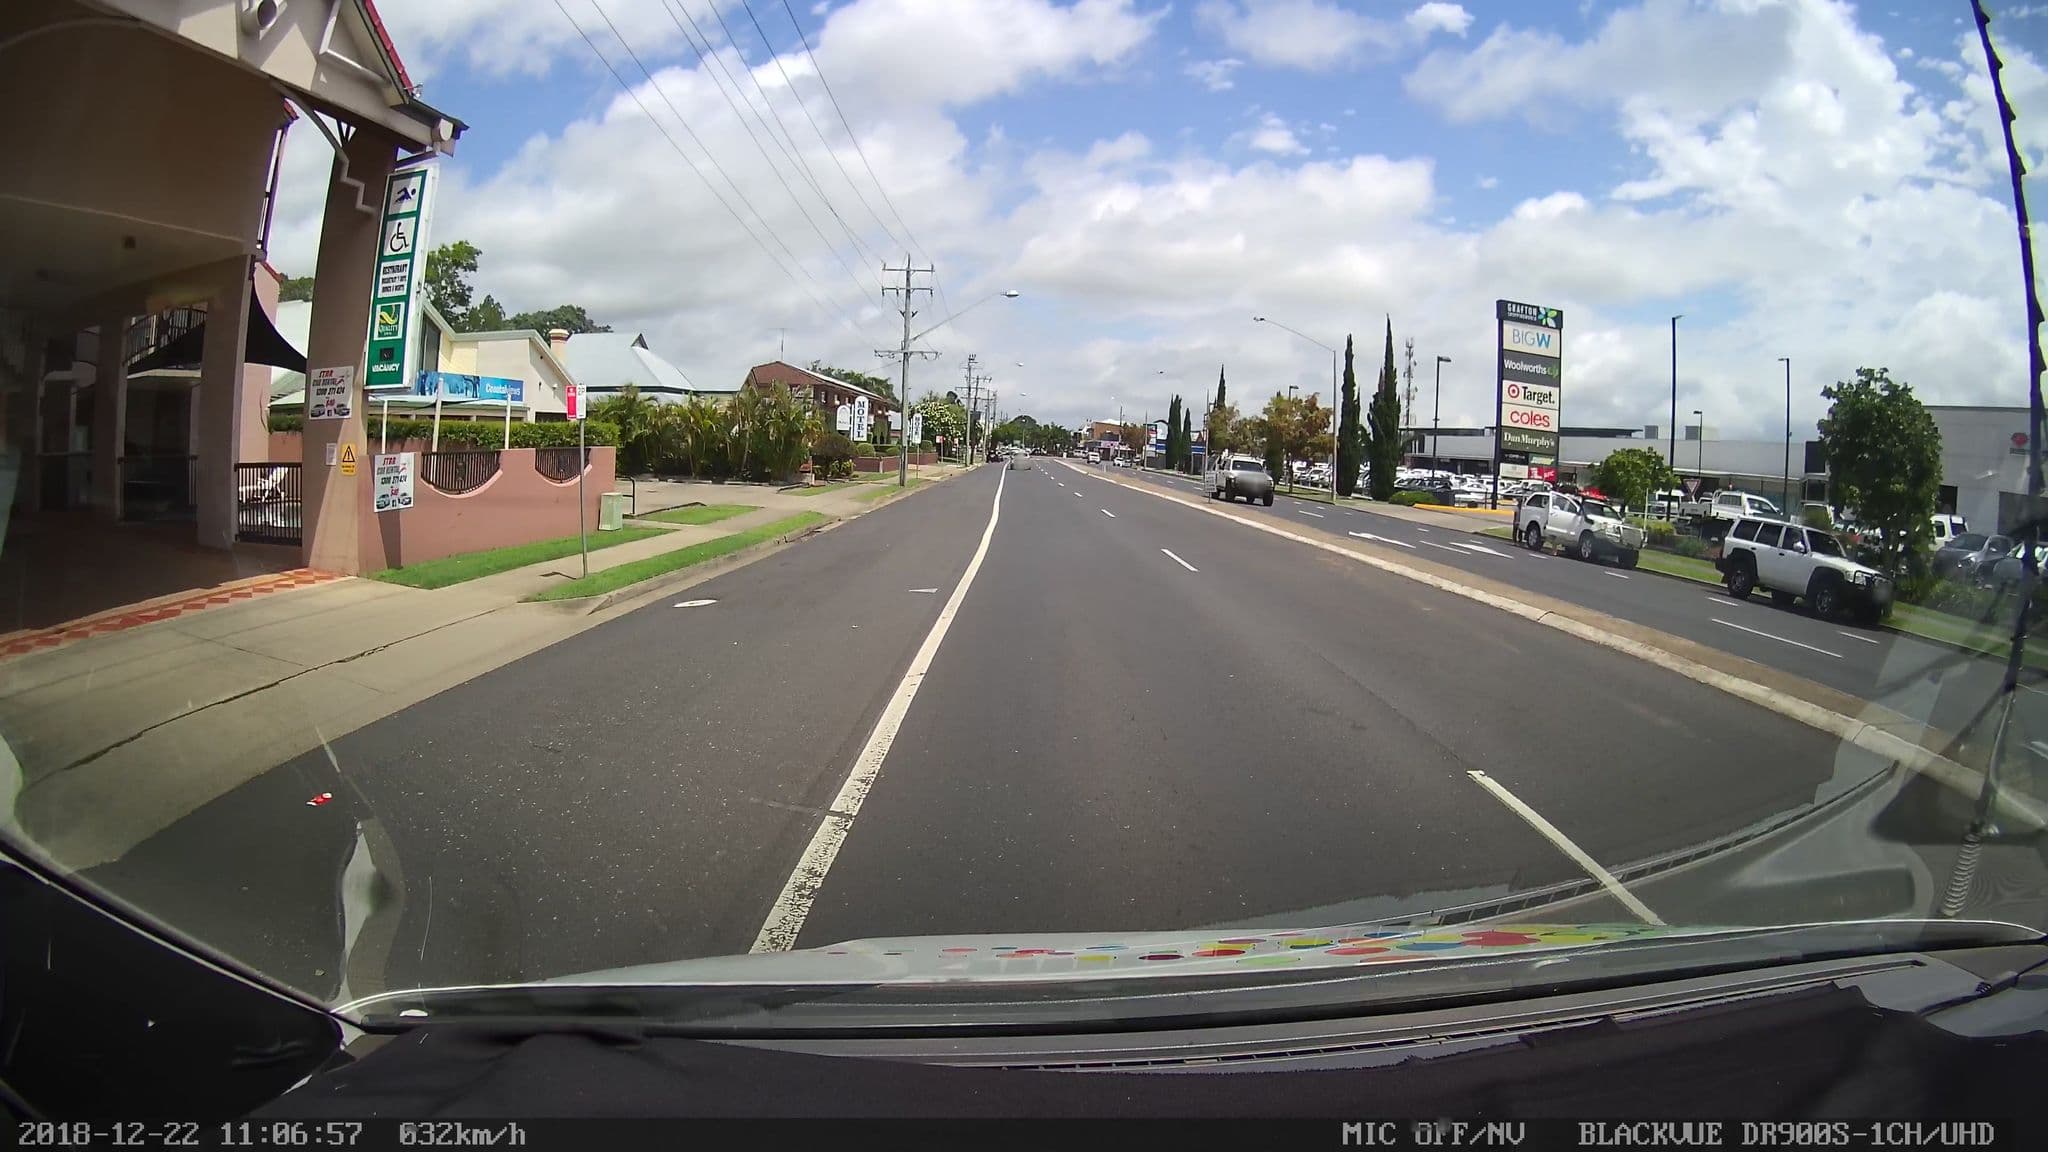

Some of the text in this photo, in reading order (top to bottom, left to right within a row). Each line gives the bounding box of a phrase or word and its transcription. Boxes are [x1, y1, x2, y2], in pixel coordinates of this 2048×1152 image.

[1507, 303, 1537, 316] GRAFTON
[372, 363, 400, 372] VACANCY
[1504, 359, 1547, 376] Woolworths
[857, 401, 865, 438] MOTEL
[1510, 410, 1550, 428] coles
[1504, 432, 1555, 449] Dan Murphy's
